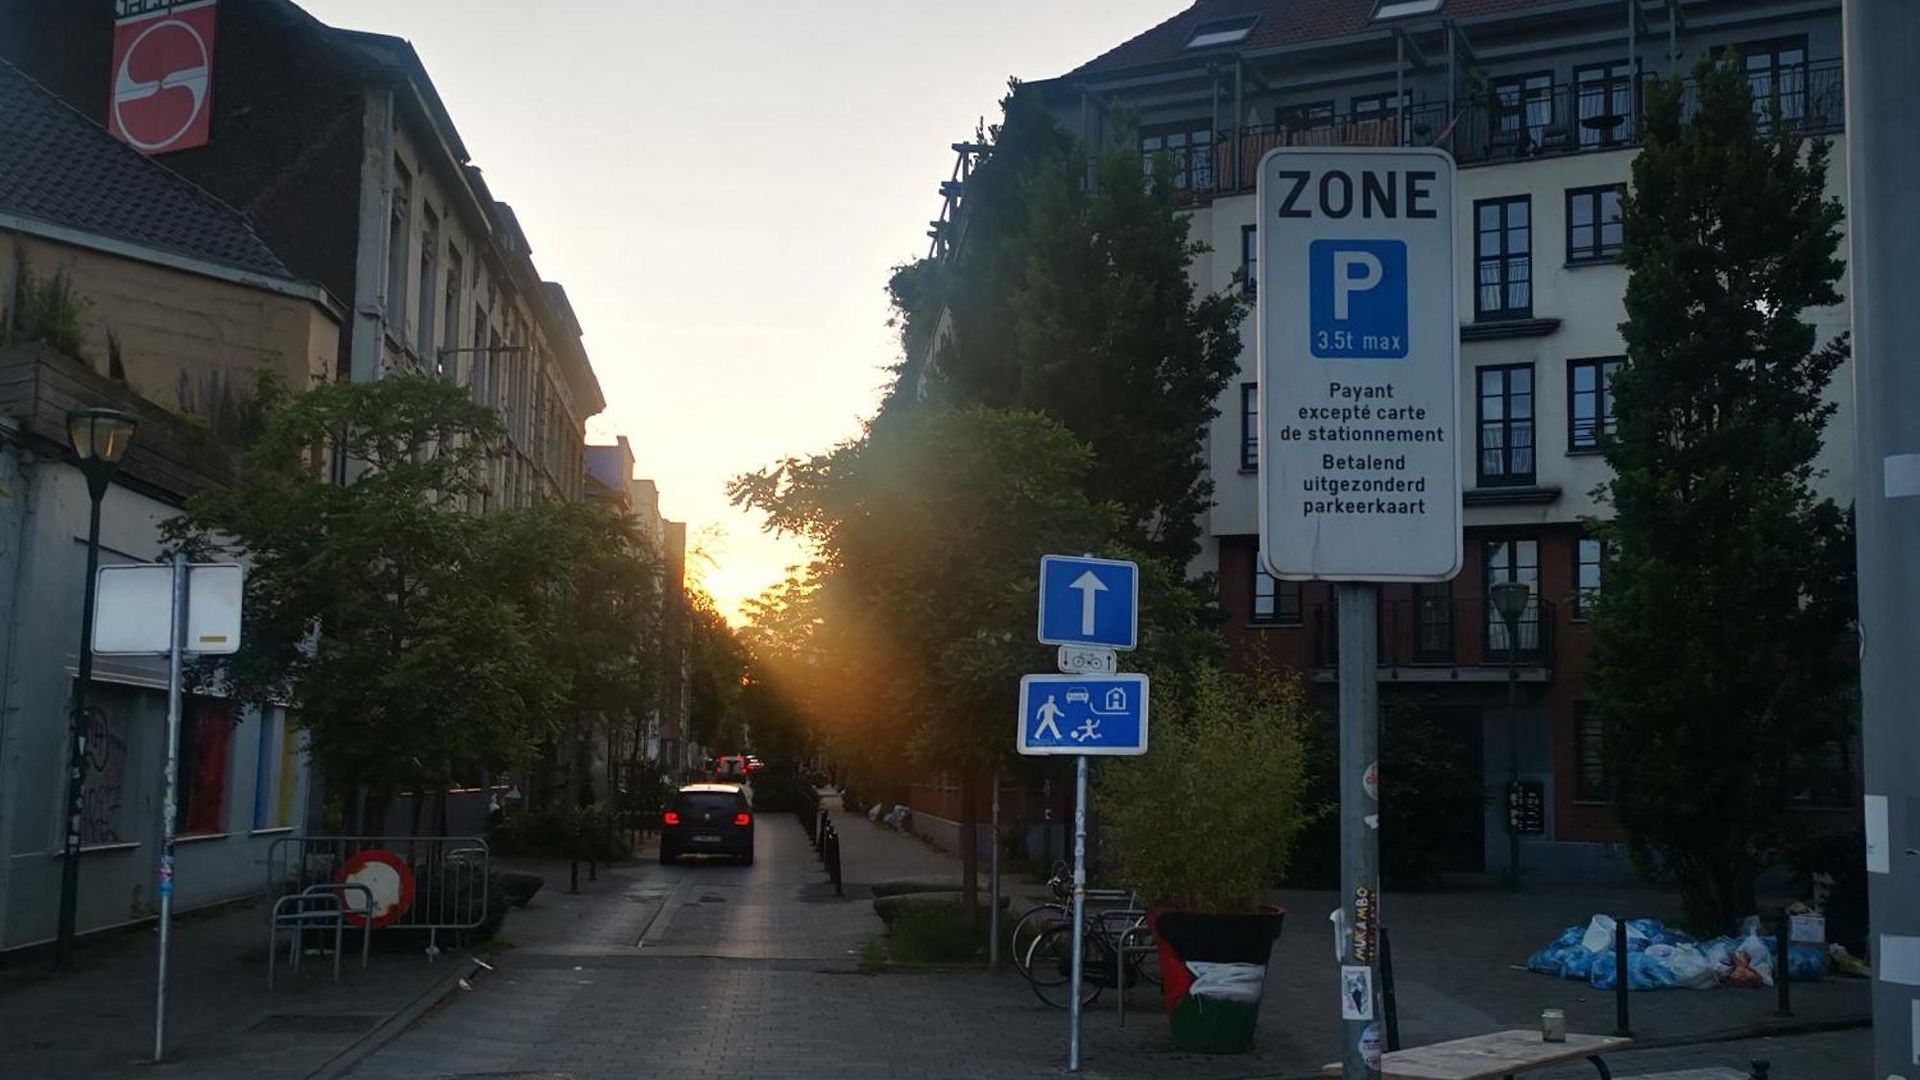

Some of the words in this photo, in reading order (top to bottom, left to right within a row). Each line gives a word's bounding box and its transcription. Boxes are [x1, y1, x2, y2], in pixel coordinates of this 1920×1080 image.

[1279, 170, 1437, 219] ZONE
[1334, 251, 1383, 320] P
[1318, 331, 1353, 350] 3.5t
[1363, 336, 1400, 350] max
[1329, 383, 1394, 402] Payant
[1298, 404, 1370, 423] excepté
[1377, 406, 1426, 420] carte
[1280, 426, 1301, 441] de
[1308, 426, 1444, 442] stationnement
[1322, 454, 1405, 470] Betalend
[1303, 477, 1425, 496] uitgezonderd
[1303, 498, 1425, 517] parkeerkaart
[1354, 887, 1368, 960] MUKAMBO
